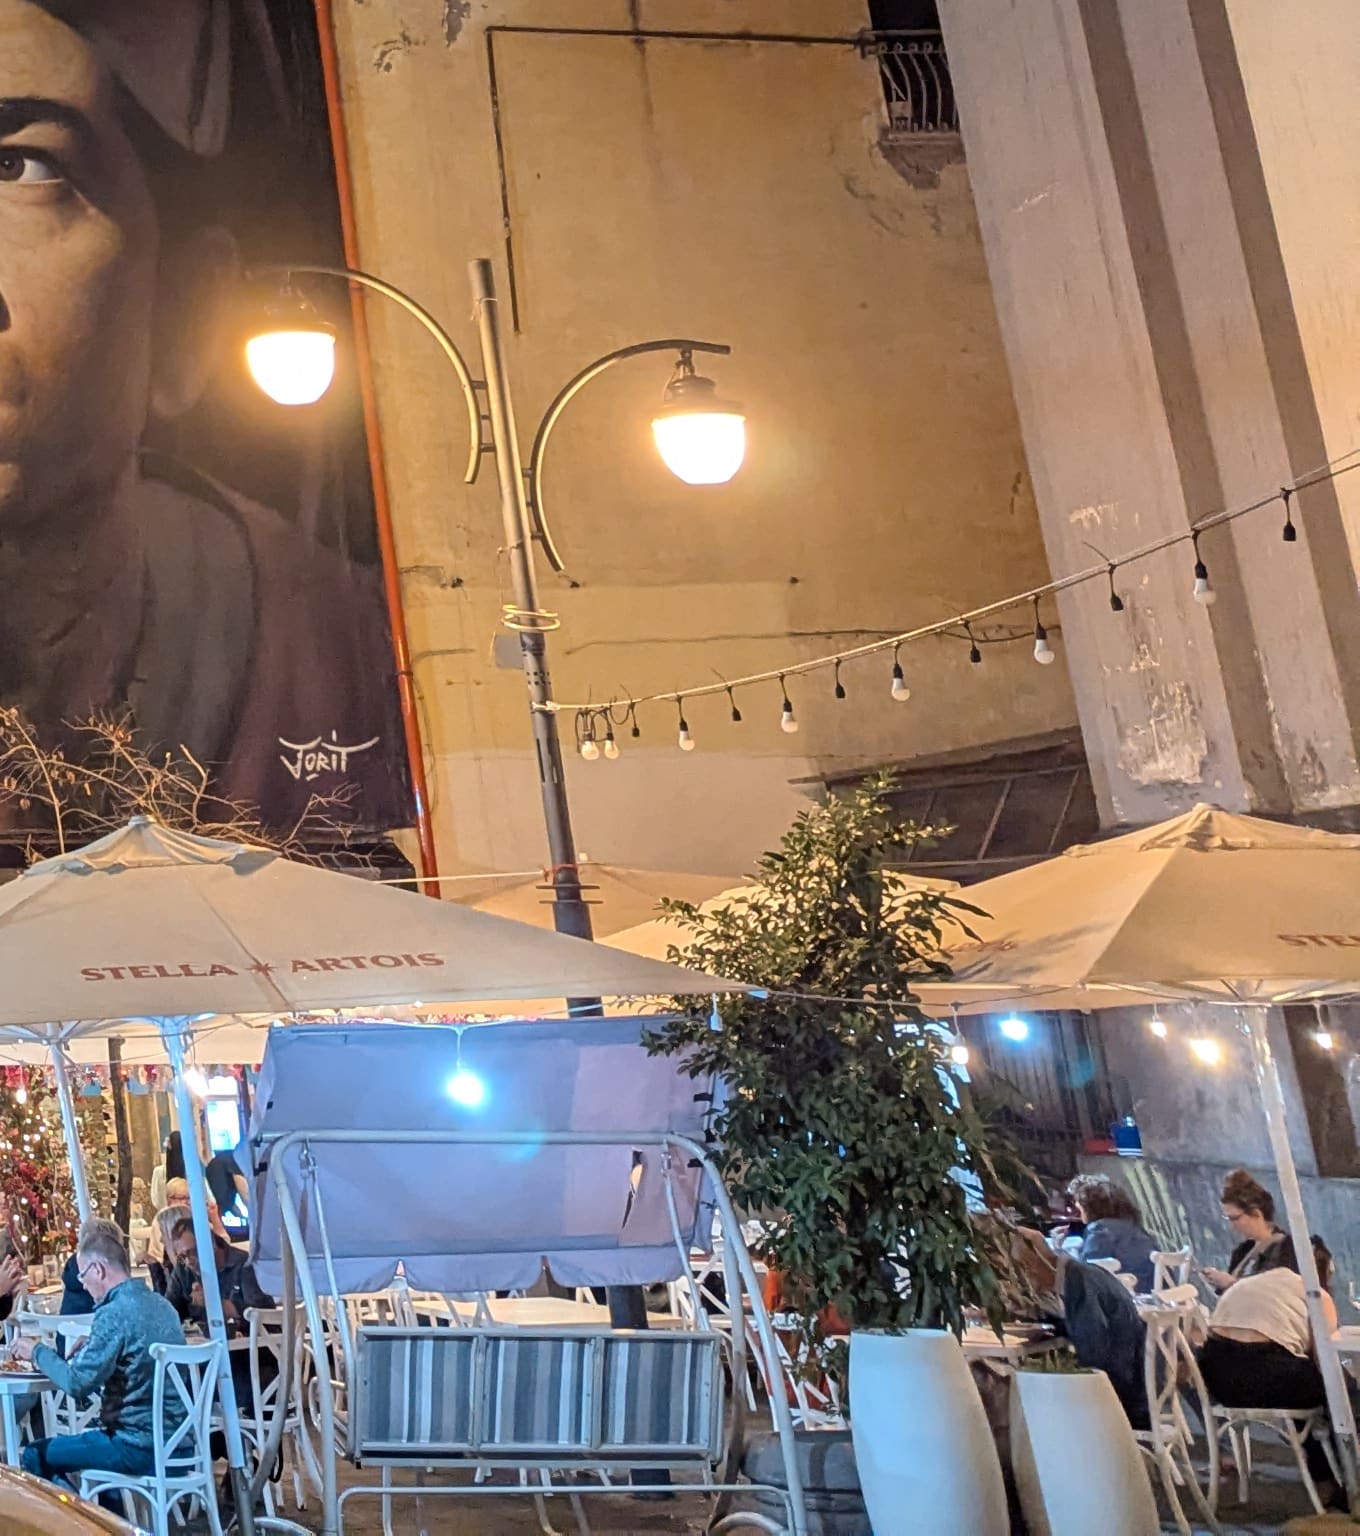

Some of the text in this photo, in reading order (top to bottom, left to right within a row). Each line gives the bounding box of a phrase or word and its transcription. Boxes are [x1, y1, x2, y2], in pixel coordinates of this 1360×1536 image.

[279, 729, 380, 781] JORIT
[80, 952, 445, 981] STELLA ARTOIS
